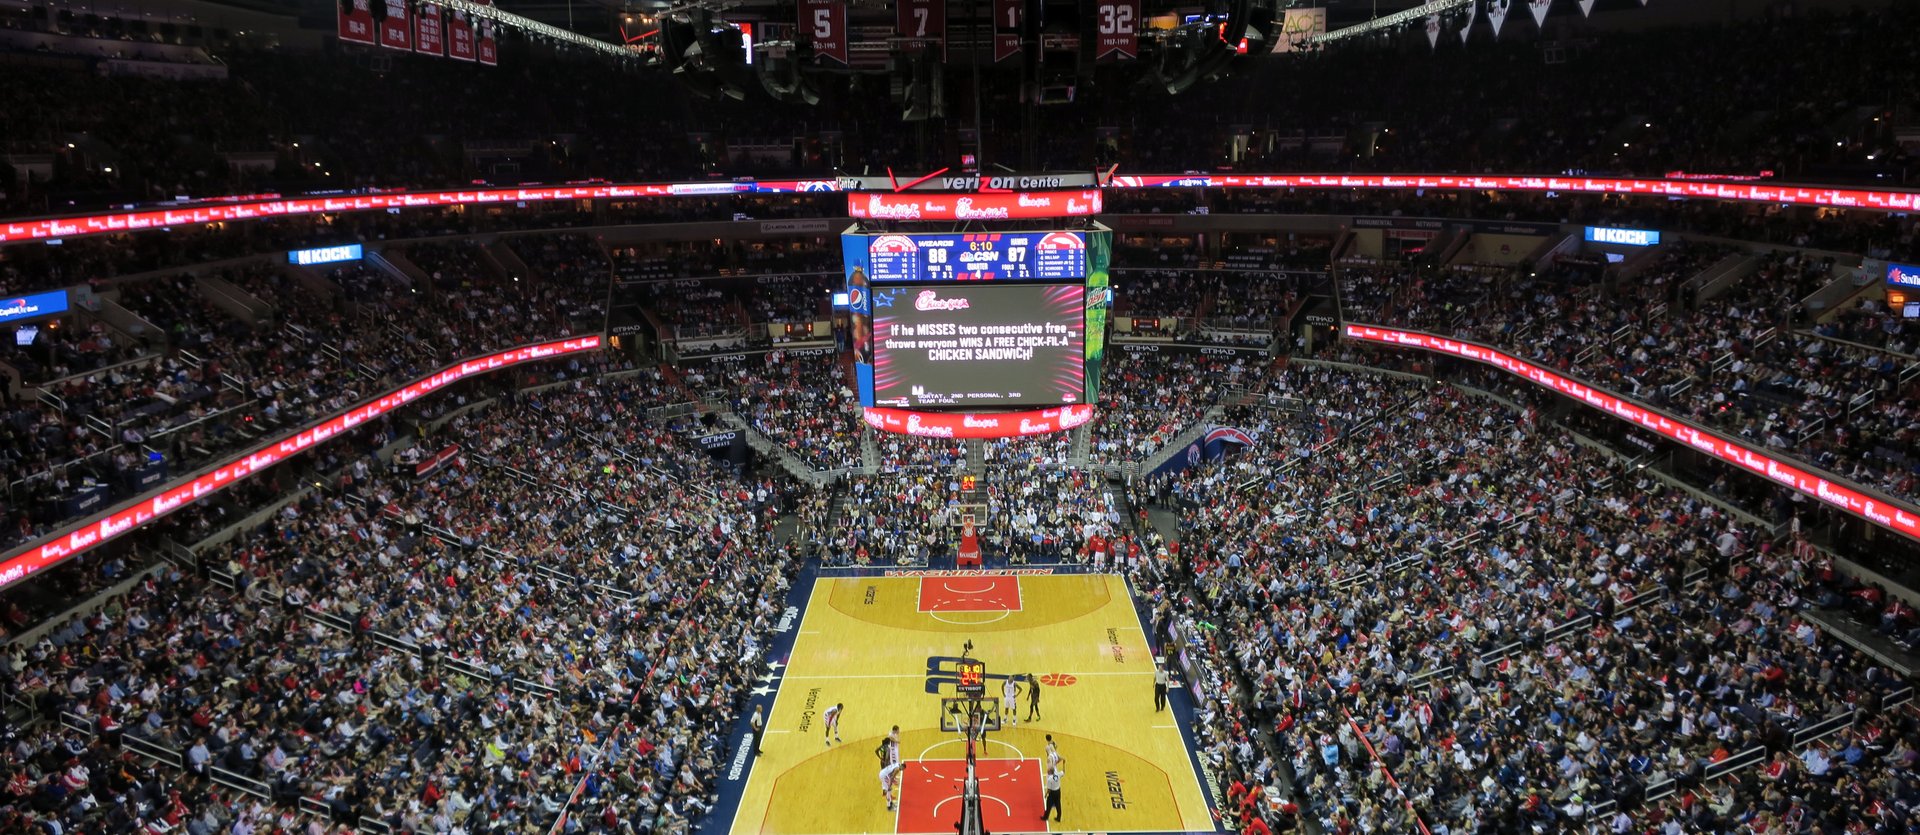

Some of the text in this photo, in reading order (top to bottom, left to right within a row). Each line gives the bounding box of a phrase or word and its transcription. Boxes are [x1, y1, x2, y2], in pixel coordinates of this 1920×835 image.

[814, 9, 831, 38] 5
[913, 7, 929, 37] 7
[1099, 4, 1133, 34] 32
[942, 174, 1064, 192] verizon Center
[1606, 228, 1647, 244] KOCH
[970, 241, 992, 251] 6:10
[311, 246, 350, 263] KOCH
[928, 248, 947, 263] 88
[974, 251, 999, 261] CSN
[1008, 247, 1026, 262] 87
[975, 270, 981, 279] 4
[1306, 315, 1334, 323] ETIHAD
[612, 324, 641, 333] ETIHAD
[890, 322, 1067, 336] If he MISSES two consecutive free
[885, 339, 916, 349] throws
[918, 340, 957, 350] everyone
[959, 337, 983, 348] WINS
[985, 337, 992, 347] A
[994, 336, 1015, 347] FREE
[1017, 336, 1069, 347] CHICK-FIL-A
[711, 354, 746, 362] ETIHAD
[928, 346, 1033, 361] CHICKEN SANDWICH!
[701, 432, 736, 444] ETIHAD
[707, 441, 730, 449] AIRWAYS
[962, 481, 974, 490] 24
[884, 569, 1054, 577] WASHINGTON
[962, 673, 978, 685] 24
[799, 687, 822, 733] Verizon Center
